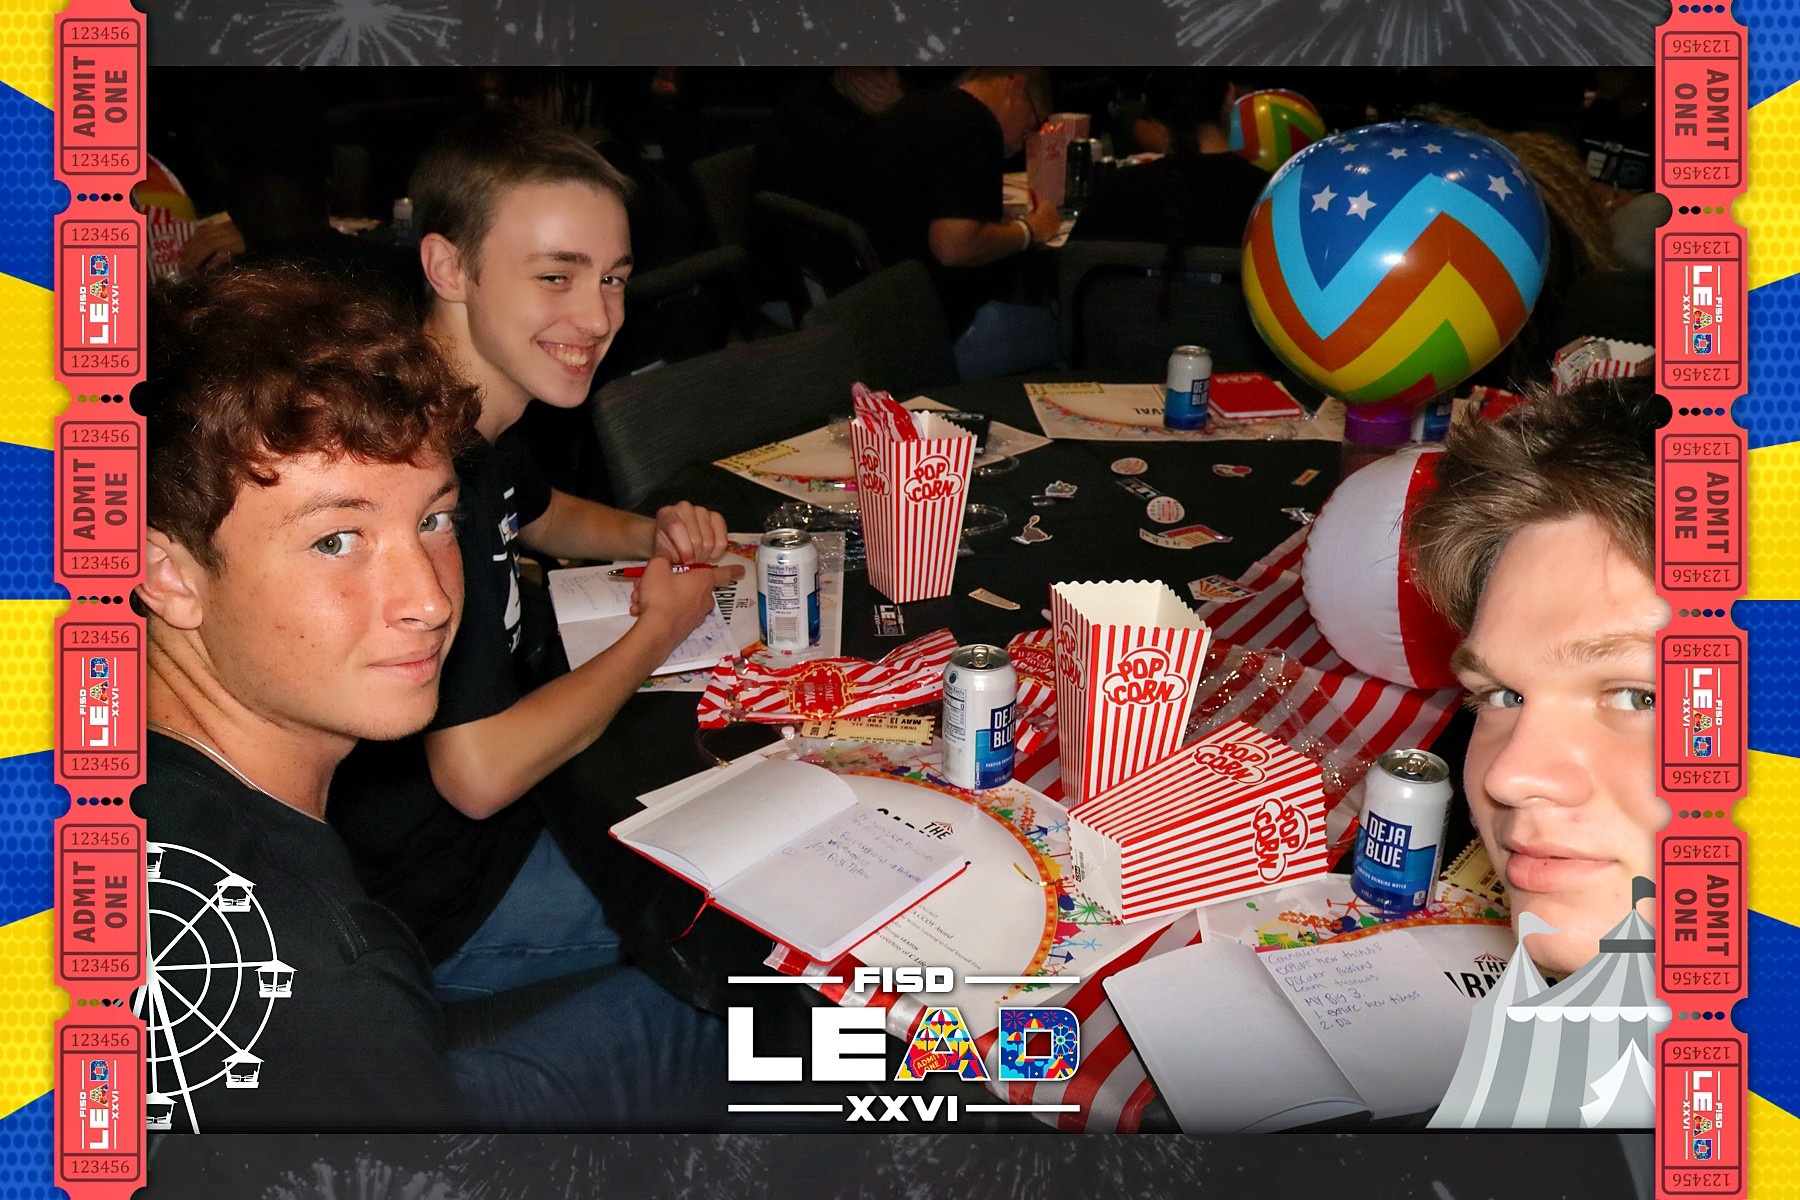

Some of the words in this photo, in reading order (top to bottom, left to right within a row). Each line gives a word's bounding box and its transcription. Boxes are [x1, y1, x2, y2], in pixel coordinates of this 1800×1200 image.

[862, 454, 879, 472] POP
[914, 462, 946, 484] POP
[862, 473, 885, 495] CORN
[912, 480, 954, 502] CORN
[1118, 658, 1164, 682] POP
[1113, 680, 1176, 705] CORN
[1219, 742, 1264, 764] POP
[1196, 752, 1254, 780] CORN
[924, 822, 952, 840] THE
[1275, 804, 1300, 848] POP
[1368, 816, 1406, 847] DEJA
[1254, 811, 1280, 868] CORN
[1365, 837, 1403, 868] BLUE
[901, 948, 909, 956] of
